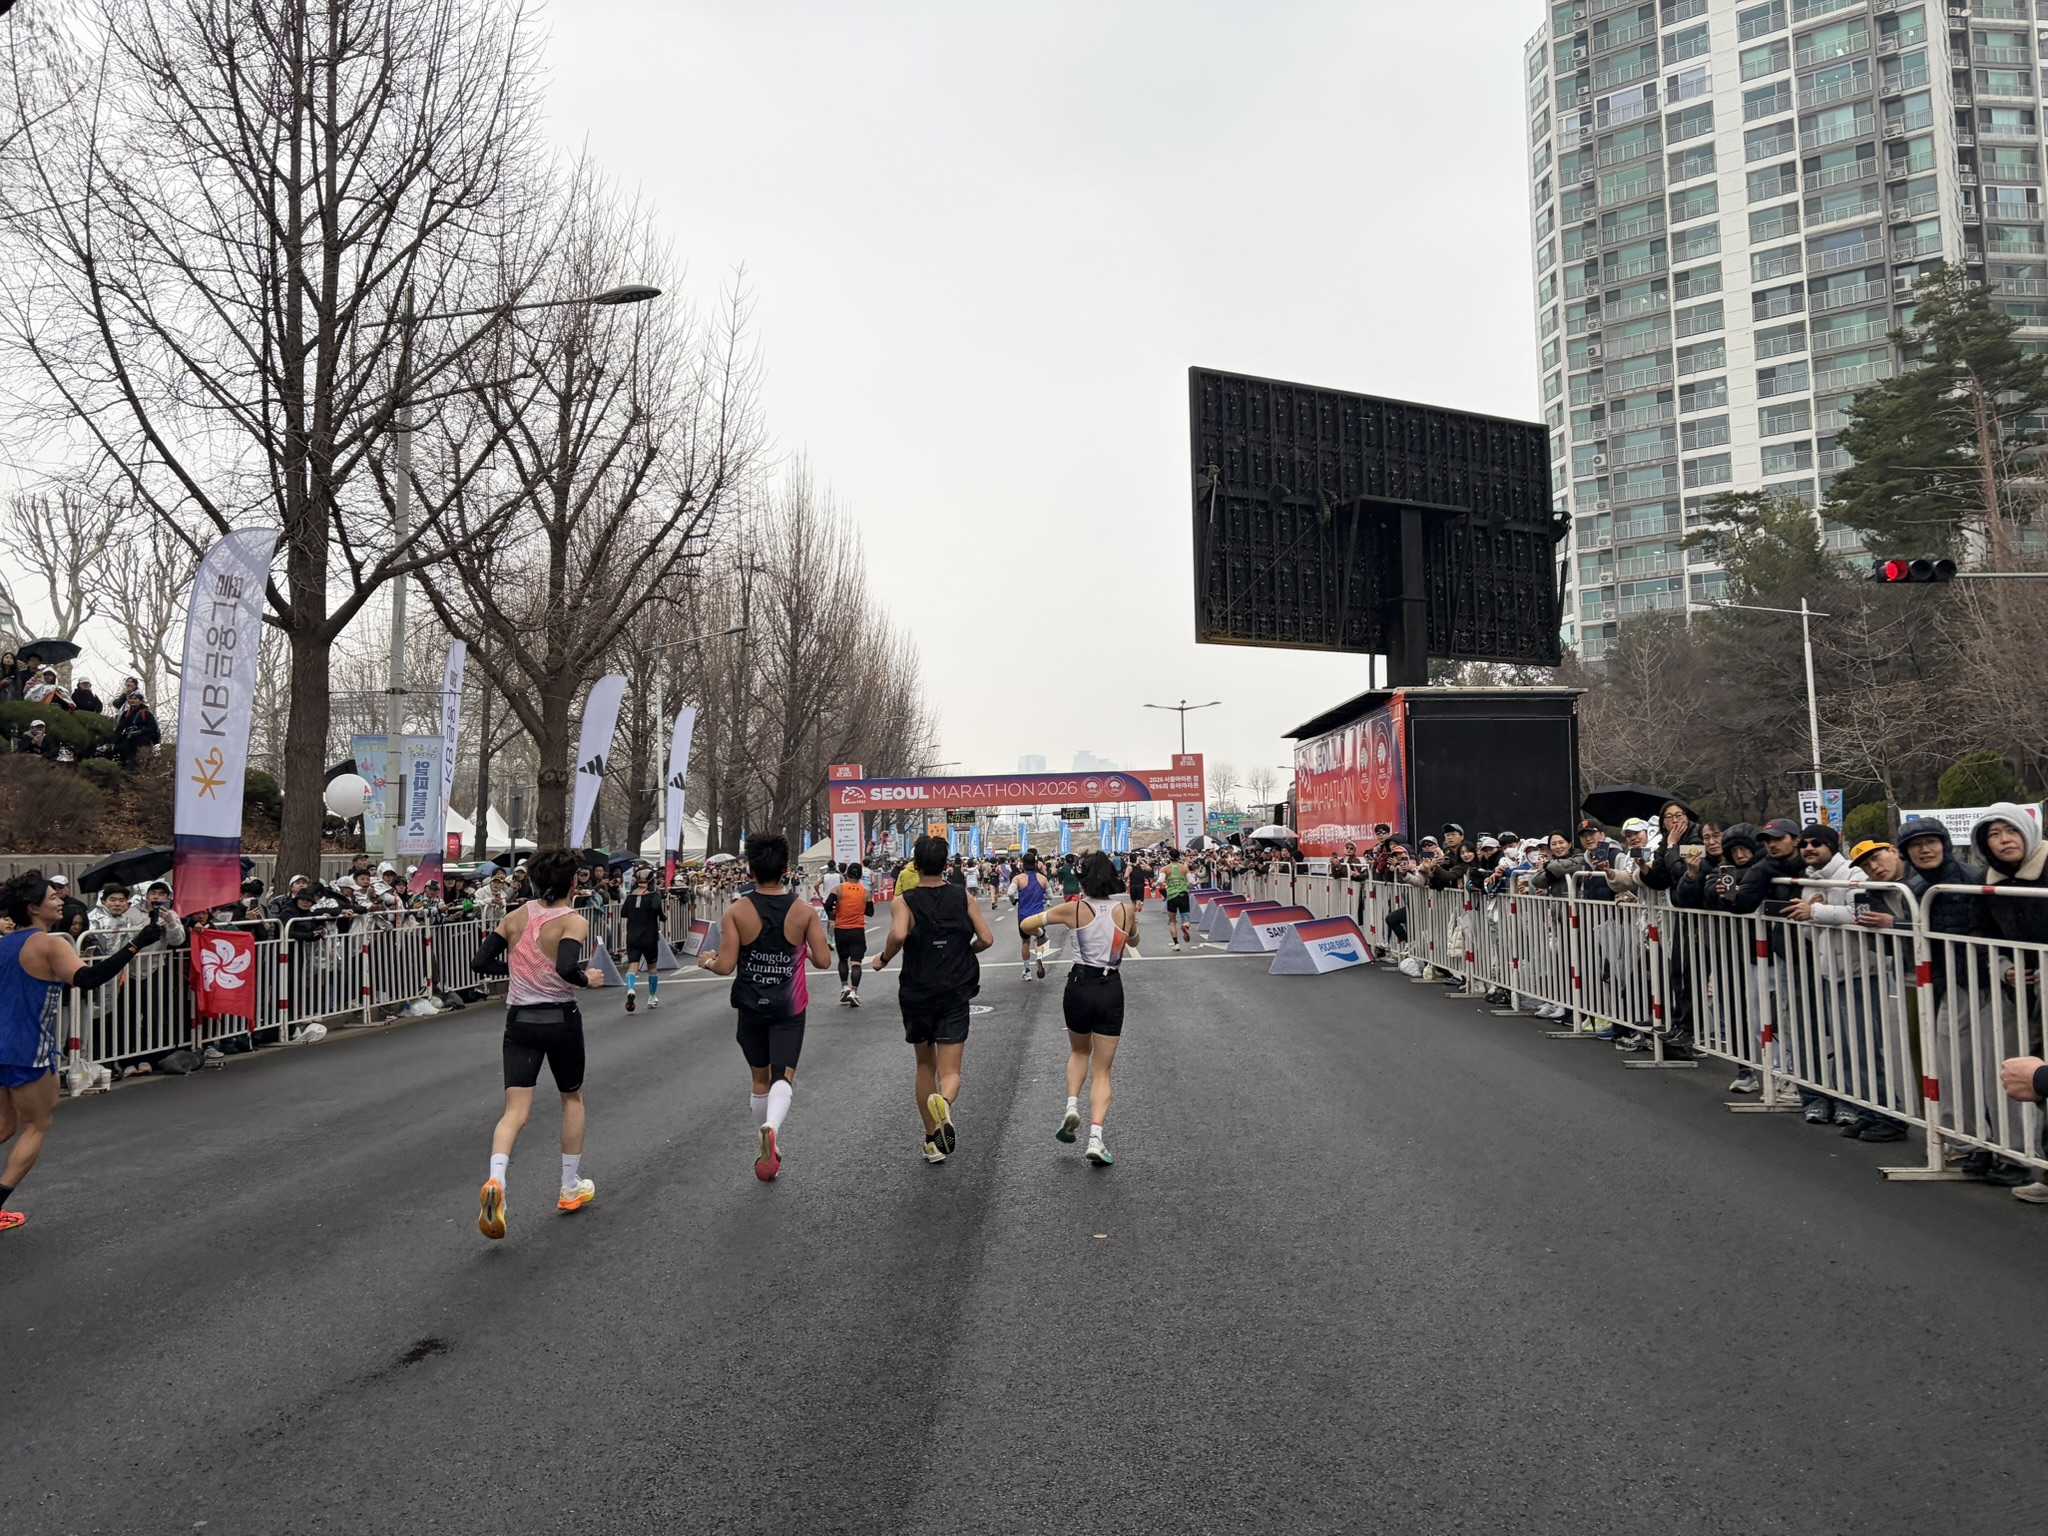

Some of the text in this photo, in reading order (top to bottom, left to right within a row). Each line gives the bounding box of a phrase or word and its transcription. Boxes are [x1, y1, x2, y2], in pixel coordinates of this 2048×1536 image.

[200, 574, 244, 737] KB금융그룹
[870, 781, 1078, 801] SEOUL MARATHON 2026
[1266, 925, 1288, 938] SAM
[749, 950, 791, 964] Songdo
[752, 973, 782, 985] Crew
